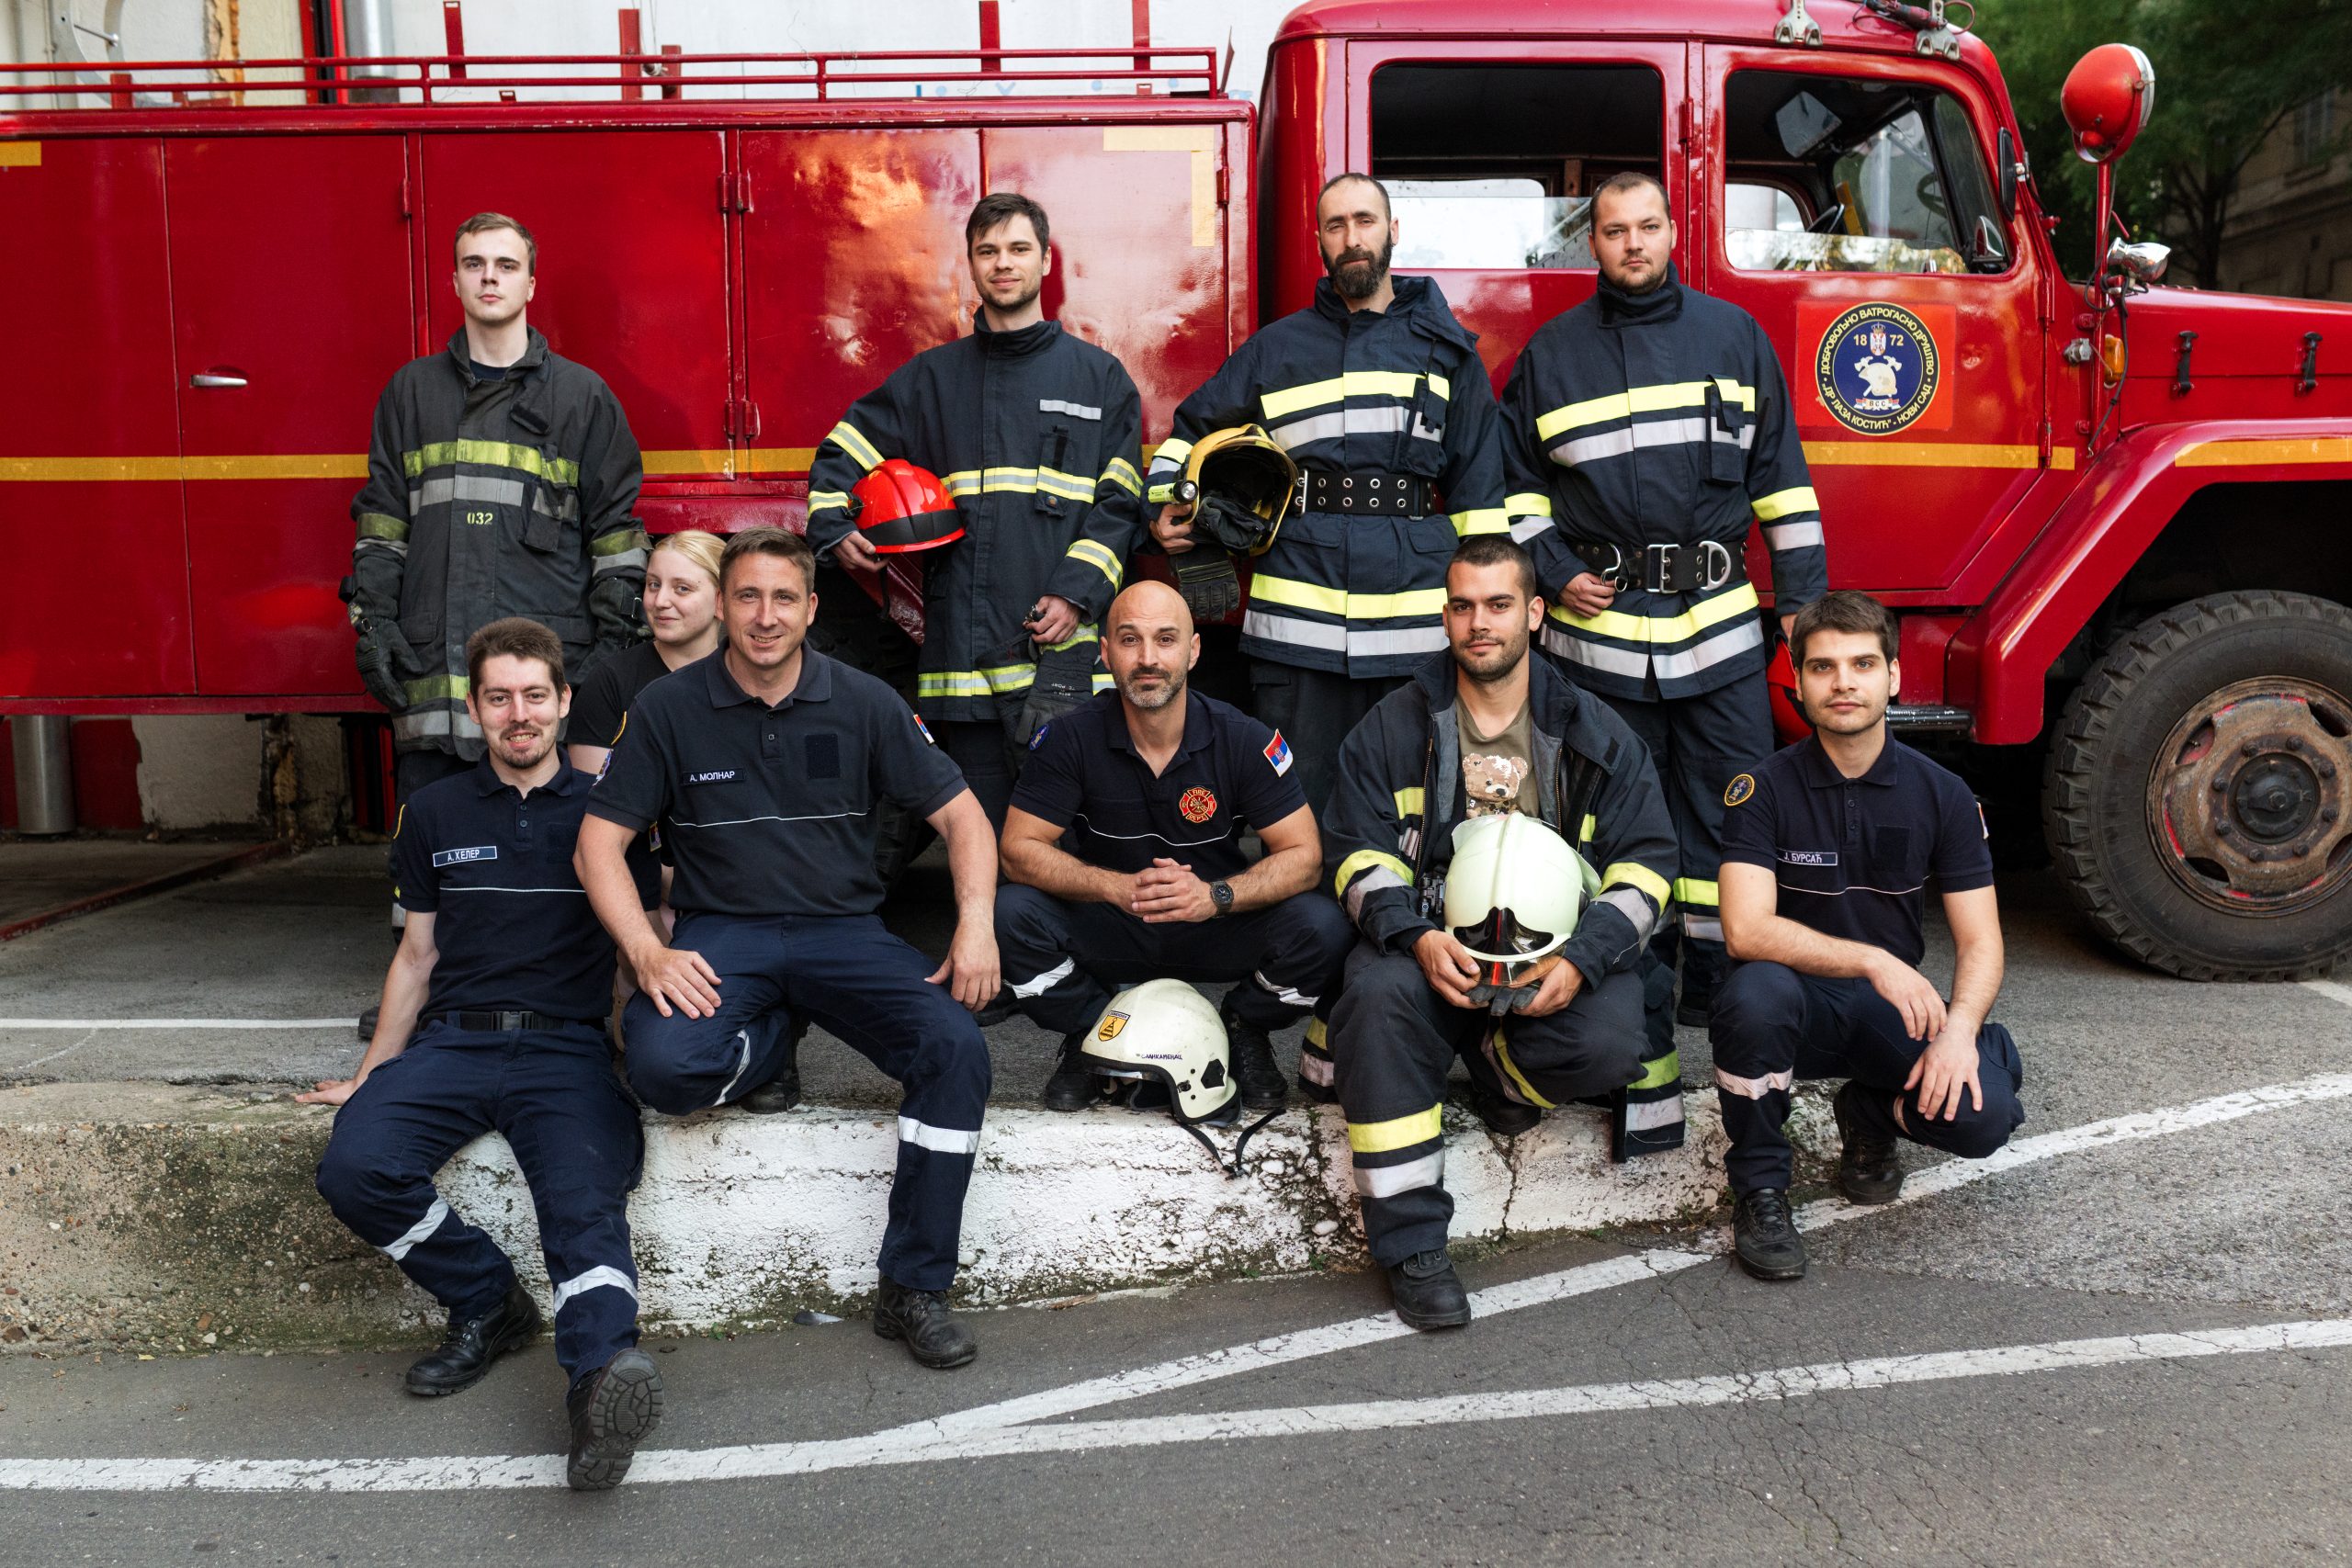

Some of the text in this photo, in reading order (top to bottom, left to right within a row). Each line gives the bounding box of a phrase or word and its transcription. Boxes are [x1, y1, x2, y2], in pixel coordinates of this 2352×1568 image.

[1821, 307, 1935, 376] ДОБРОВОЉНО ВАТРОГАСНО ДРУШТВО
[1853, 333, 1905, 346] 18 72
[1831, 399, 1851, 423] ЛАЗА
[1897, 402, 1919, 424] НОВИ
[1918, 385, 1933, 404] САД
[467, 512, 493, 525] 032
[699, 771, 735, 781] МОЛНАР
[455, 849, 480, 860] ХЕЛЕР
[1791, 852, 1822, 863] БУРСАЋ
